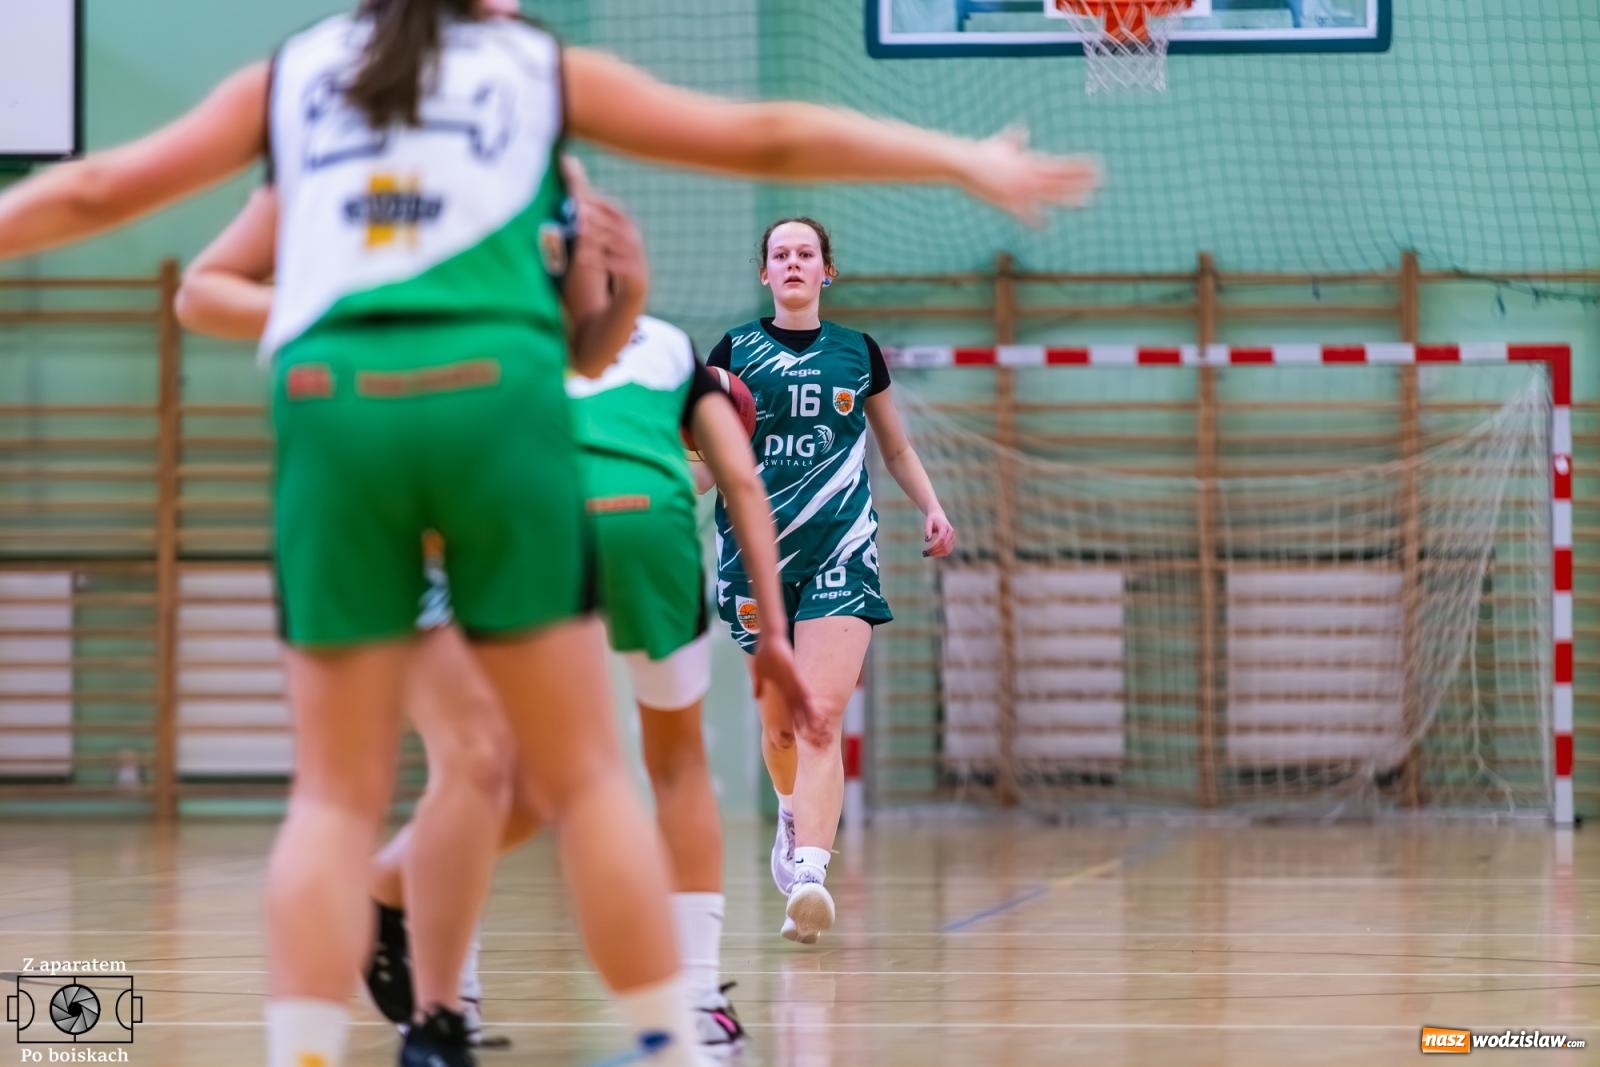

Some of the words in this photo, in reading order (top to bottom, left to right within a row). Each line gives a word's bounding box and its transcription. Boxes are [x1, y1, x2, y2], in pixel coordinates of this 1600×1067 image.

[781, 368, 821, 377] regio
[788, 383, 822, 417] 16
[764, 434, 815, 457] DIG
[812, 590, 852, 600] regio
